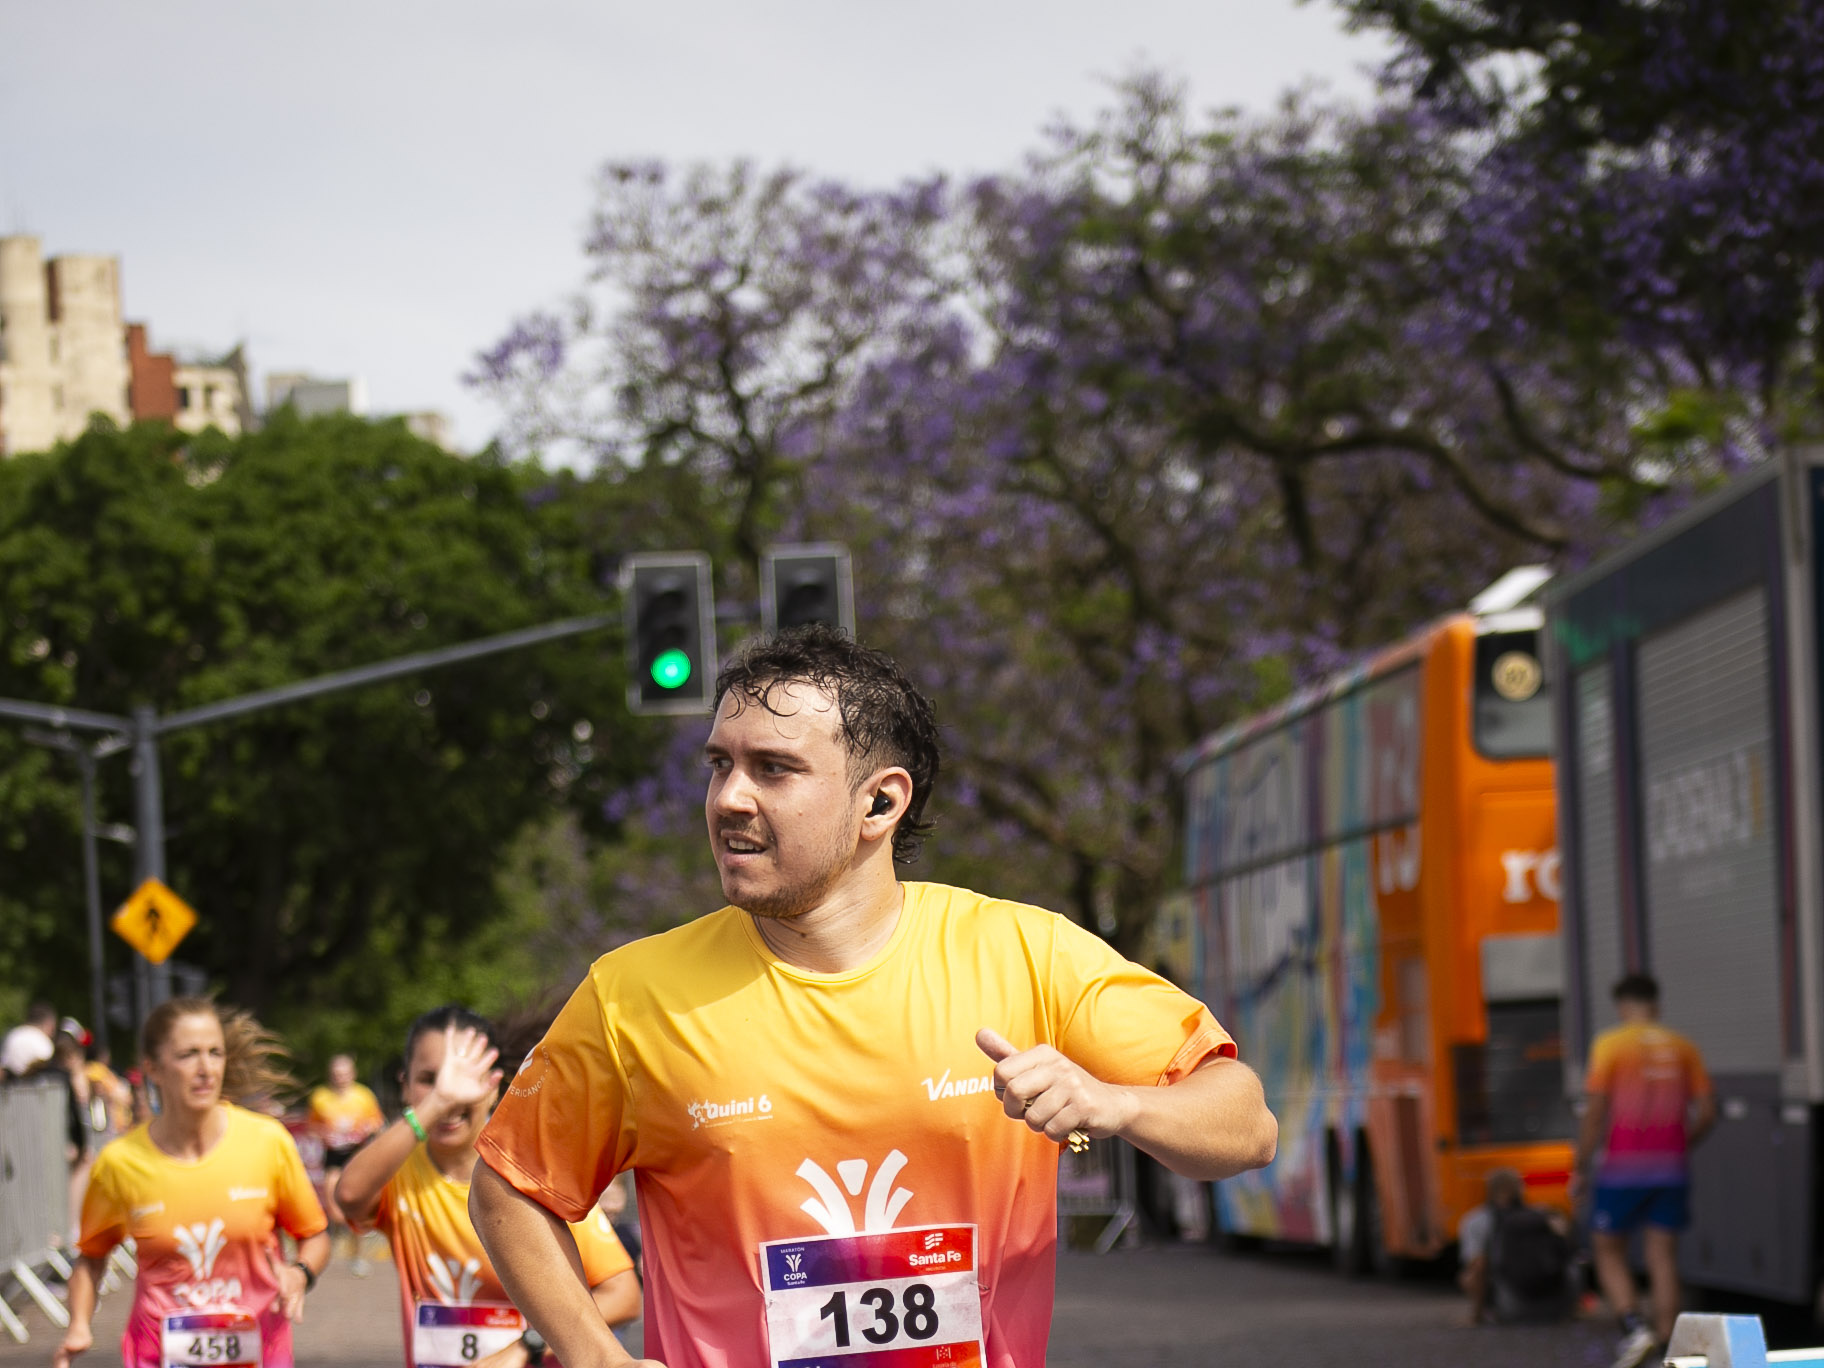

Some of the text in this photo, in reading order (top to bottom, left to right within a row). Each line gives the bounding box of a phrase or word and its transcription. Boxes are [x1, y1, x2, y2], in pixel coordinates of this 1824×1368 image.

[921, 1068, 995, 1101] VANDA
[707, 1094, 772, 1119] Quini 6
[909, 1250, 962, 1266] Santa Fe
[783, 1272, 807, 1281] COPA
[820, 1283, 939, 1348] 138
[188, 1334, 241, 1361] 458
[461, 1333, 478, 1360] 8
